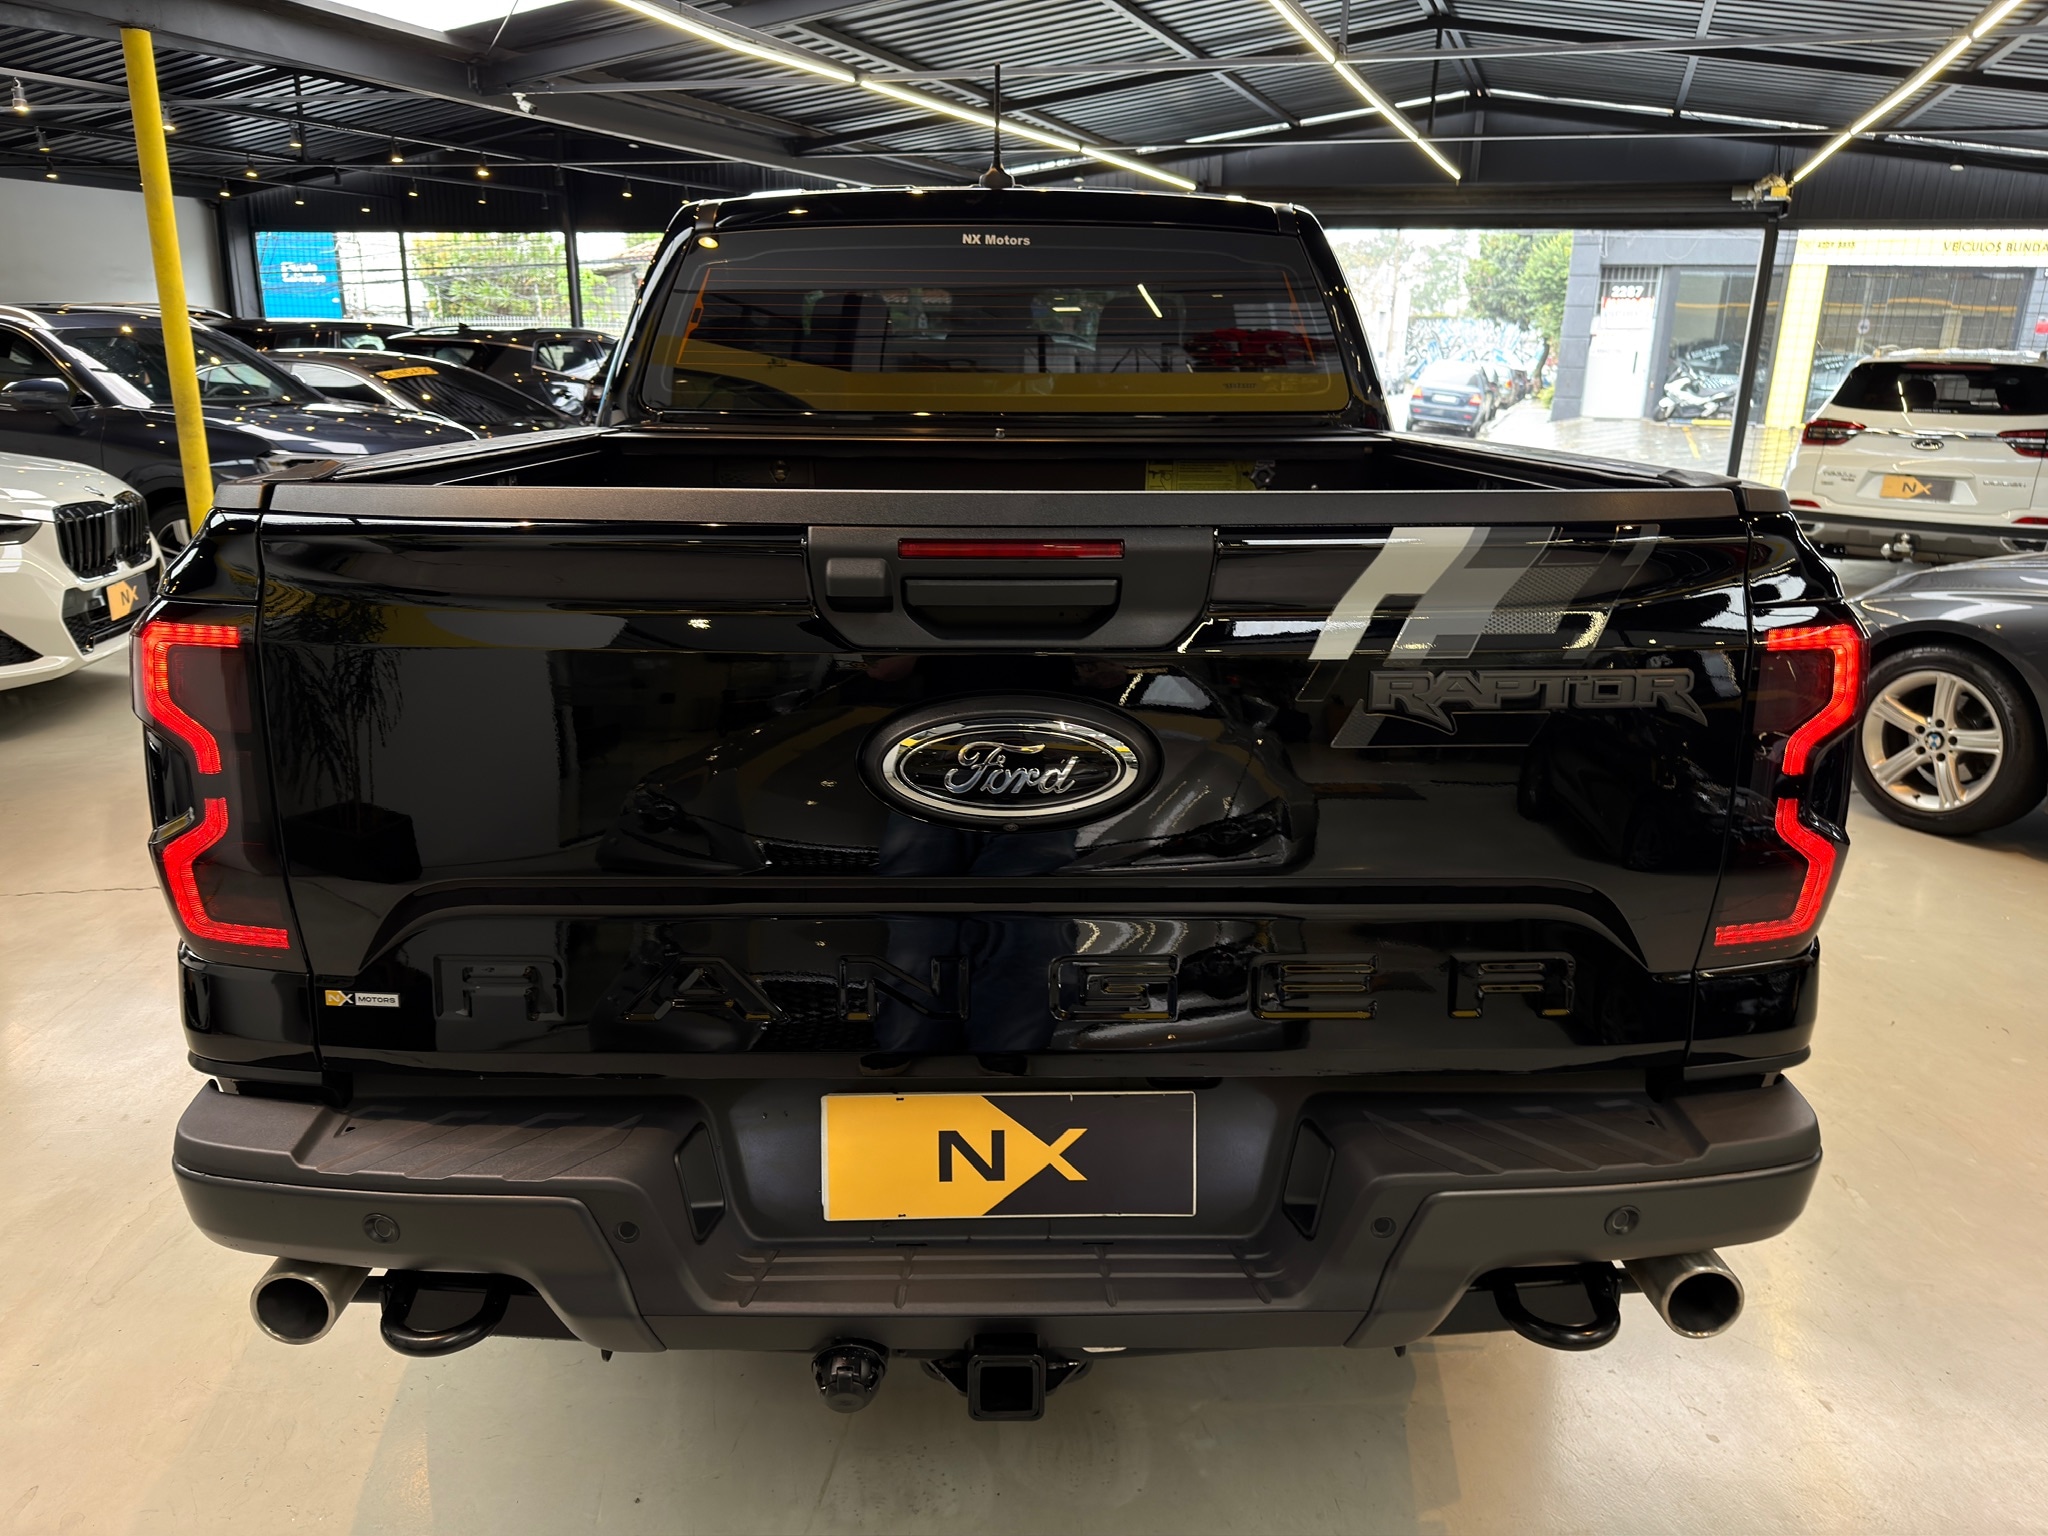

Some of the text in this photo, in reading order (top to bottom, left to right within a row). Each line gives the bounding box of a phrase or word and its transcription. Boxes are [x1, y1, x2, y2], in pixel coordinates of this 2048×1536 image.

[962, 233, 1031, 246] NX Motors
[1902, 482, 1933, 496] NX
[120, 585, 139, 606] NX
[1369, 668, 1709, 732] RAPTOR
[943, 741, 1080, 794] Ford
[327, 993, 354, 1004] NX
[433, 951, 1577, 1022] RANGER
[937, 1128, 1089, 1183] NX
